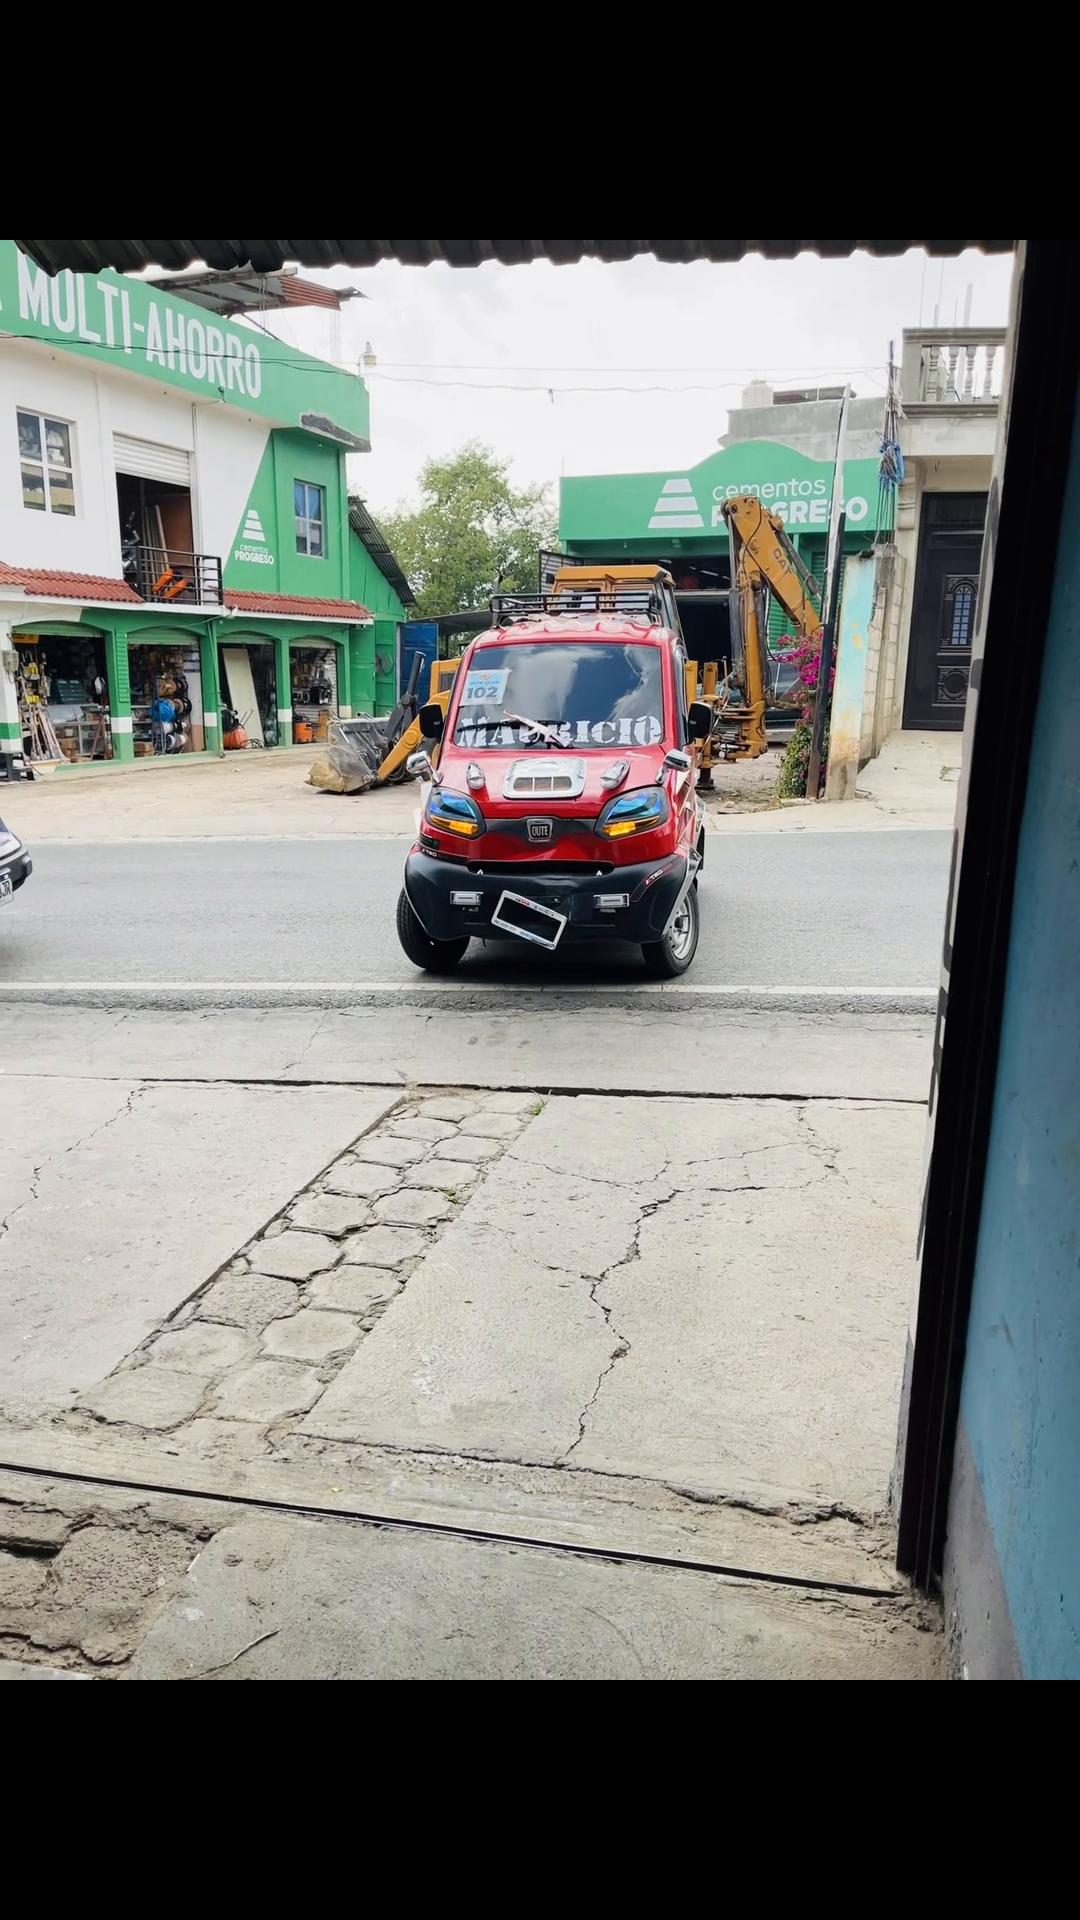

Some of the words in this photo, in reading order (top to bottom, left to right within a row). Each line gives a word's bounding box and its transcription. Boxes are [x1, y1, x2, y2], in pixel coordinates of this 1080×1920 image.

[16, 247, 262, 398] MULTI-AHORRO
[712, 479, 826, 500] cementos
[711, 496, 868, 528] PGREO
[235, 550, 274, 564] PROGRESO
[467, 687, 498, 699] 102
[457, 715, 663, 747] MAURICIO
